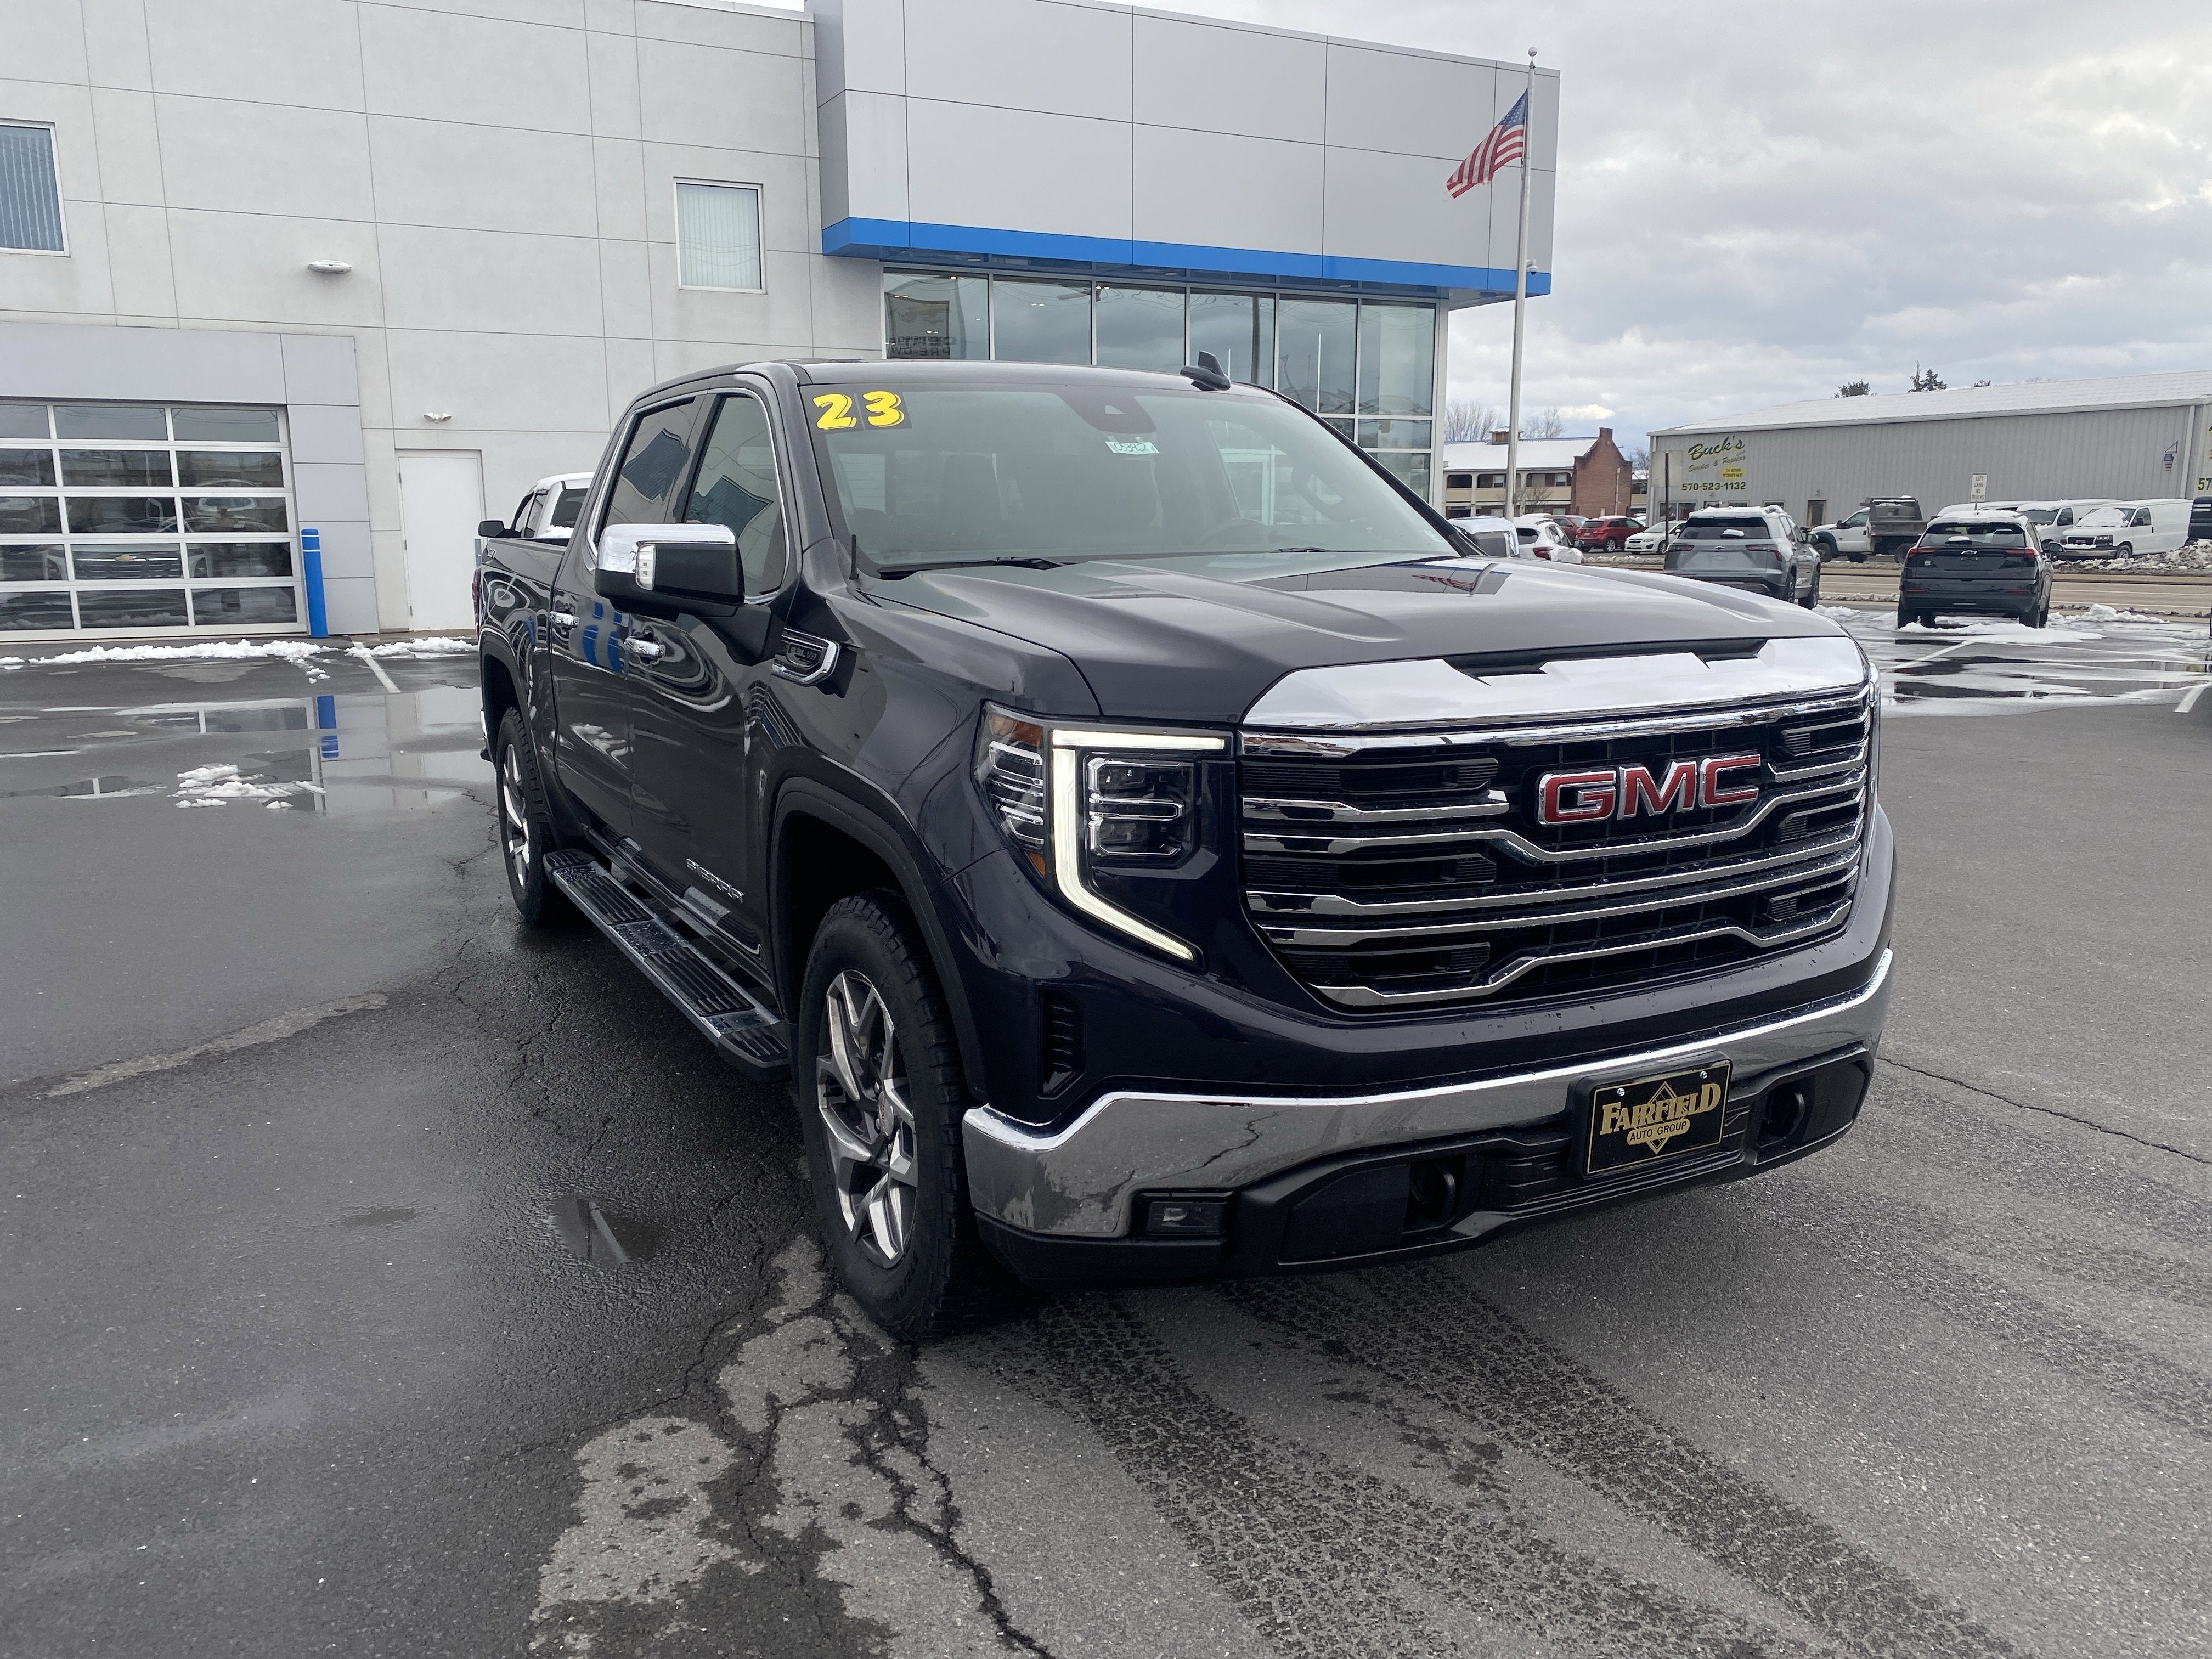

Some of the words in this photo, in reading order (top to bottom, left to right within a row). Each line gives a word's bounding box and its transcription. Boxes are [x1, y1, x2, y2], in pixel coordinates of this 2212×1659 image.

[812, 390, 905, 430] 23
[1688, 436, 1746, 460] Buck's
[1681, 482, 1746, 491] 570-523-1132
[1538, 754, 1761, 825] GMC
[1600, 1083, 1721, 1135] FAIRFIELD
[1630, 1128, 1653, 1142] AUTO
[1657, 1121, 1687, 1135] GROUP
